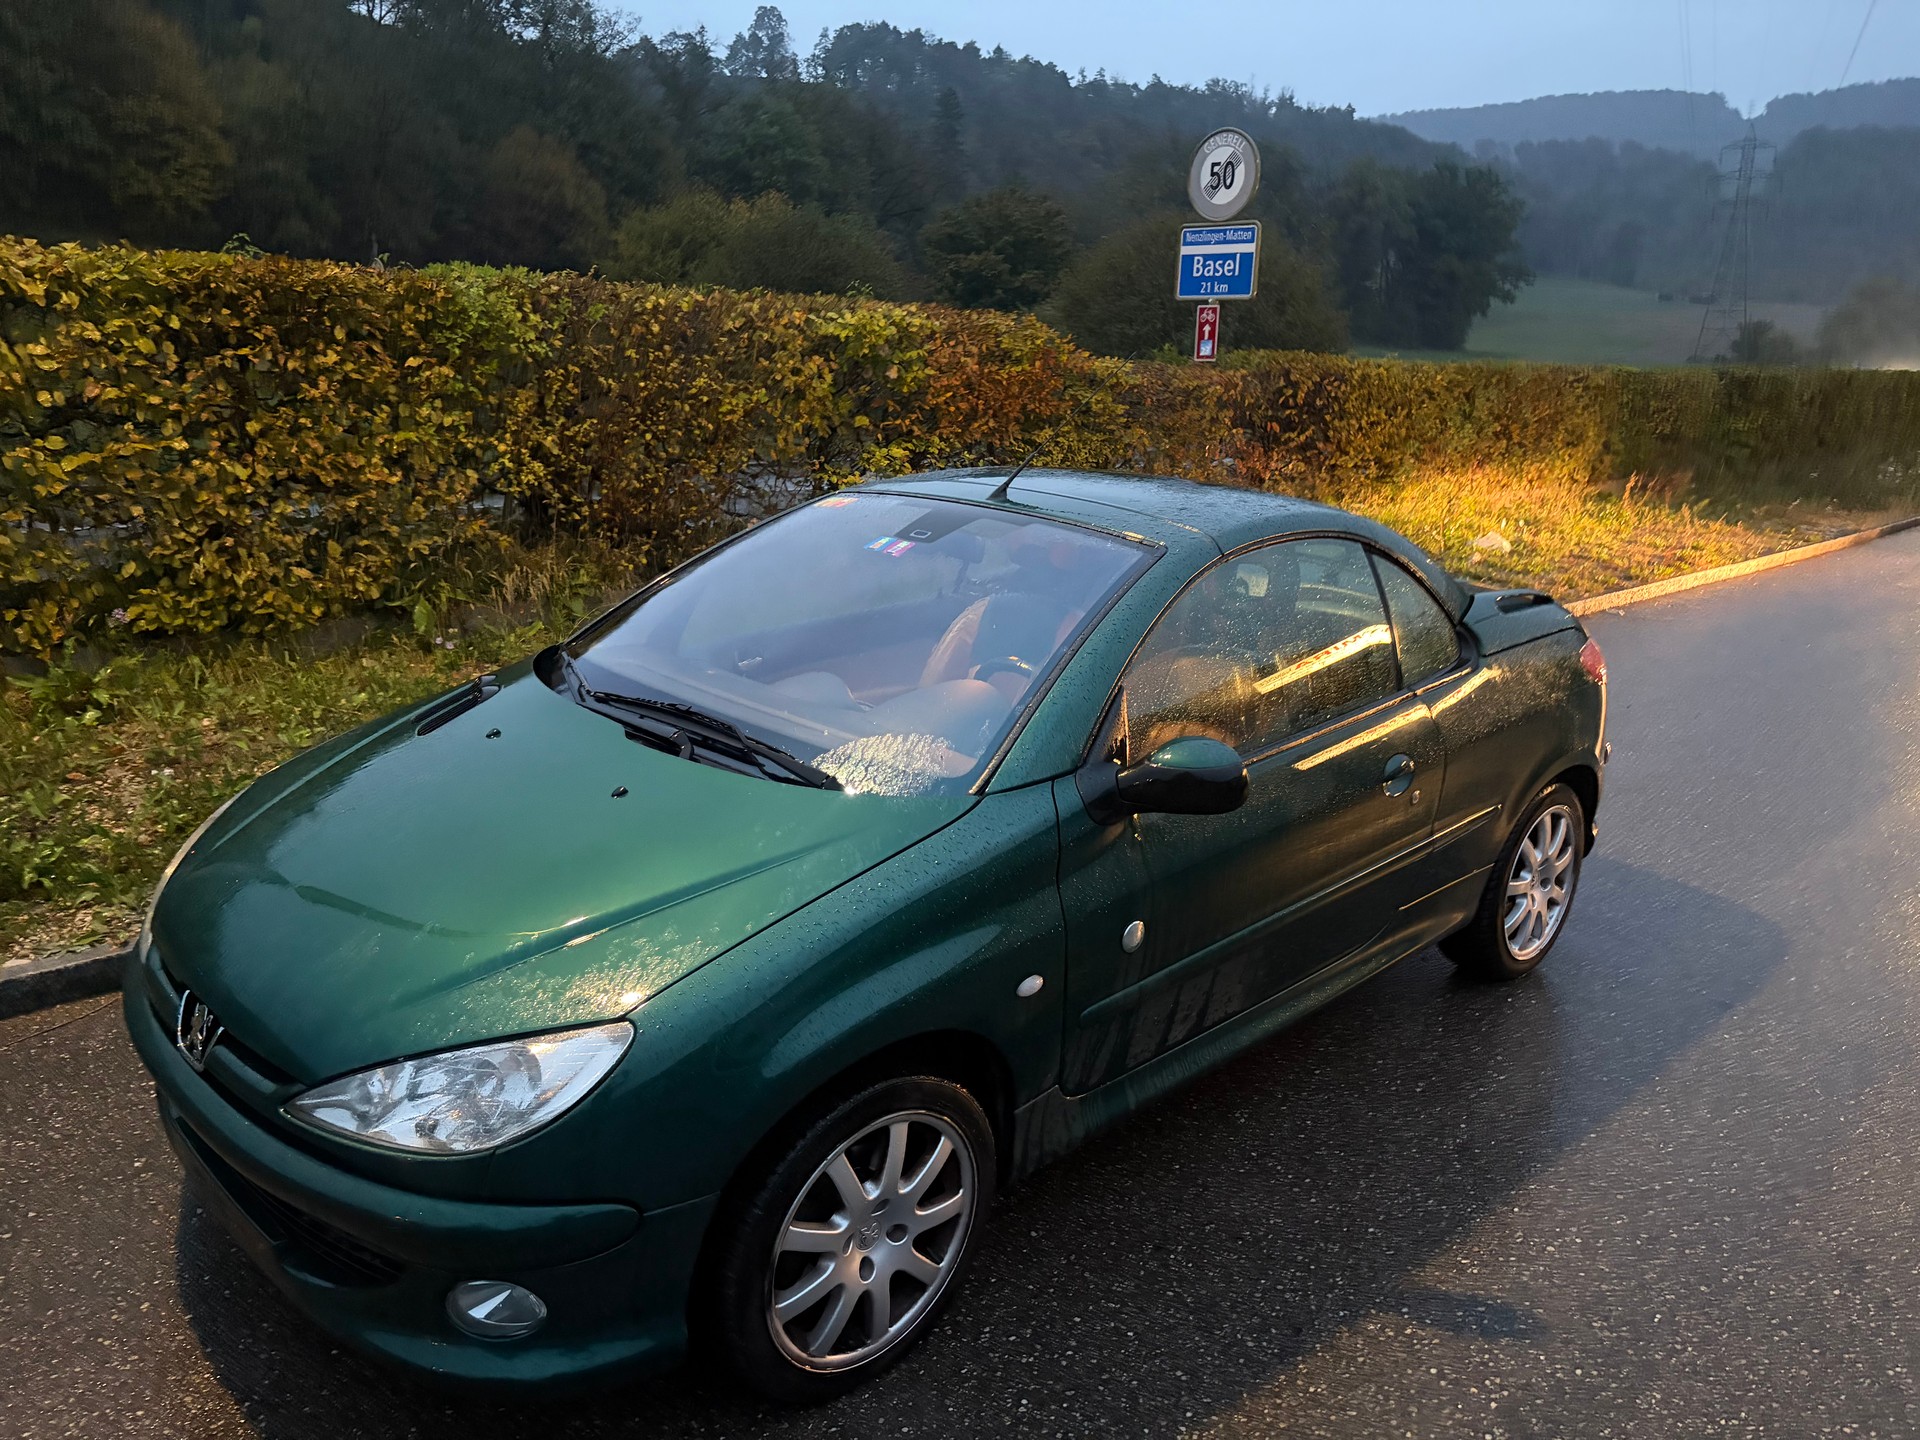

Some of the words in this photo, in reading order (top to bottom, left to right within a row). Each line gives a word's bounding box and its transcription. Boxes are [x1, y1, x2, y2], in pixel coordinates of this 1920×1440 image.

[1203, 133, 1246, 153] GENERELL
[1210, 161, 1235, 190] 50
[1186, 230, 1252, 244] Nenzlingen-Matten
[1192, 253, 1240, 277] Basel
[1200, 282, 1211, 293] 21
[1214, 281, 1228, 292] km
